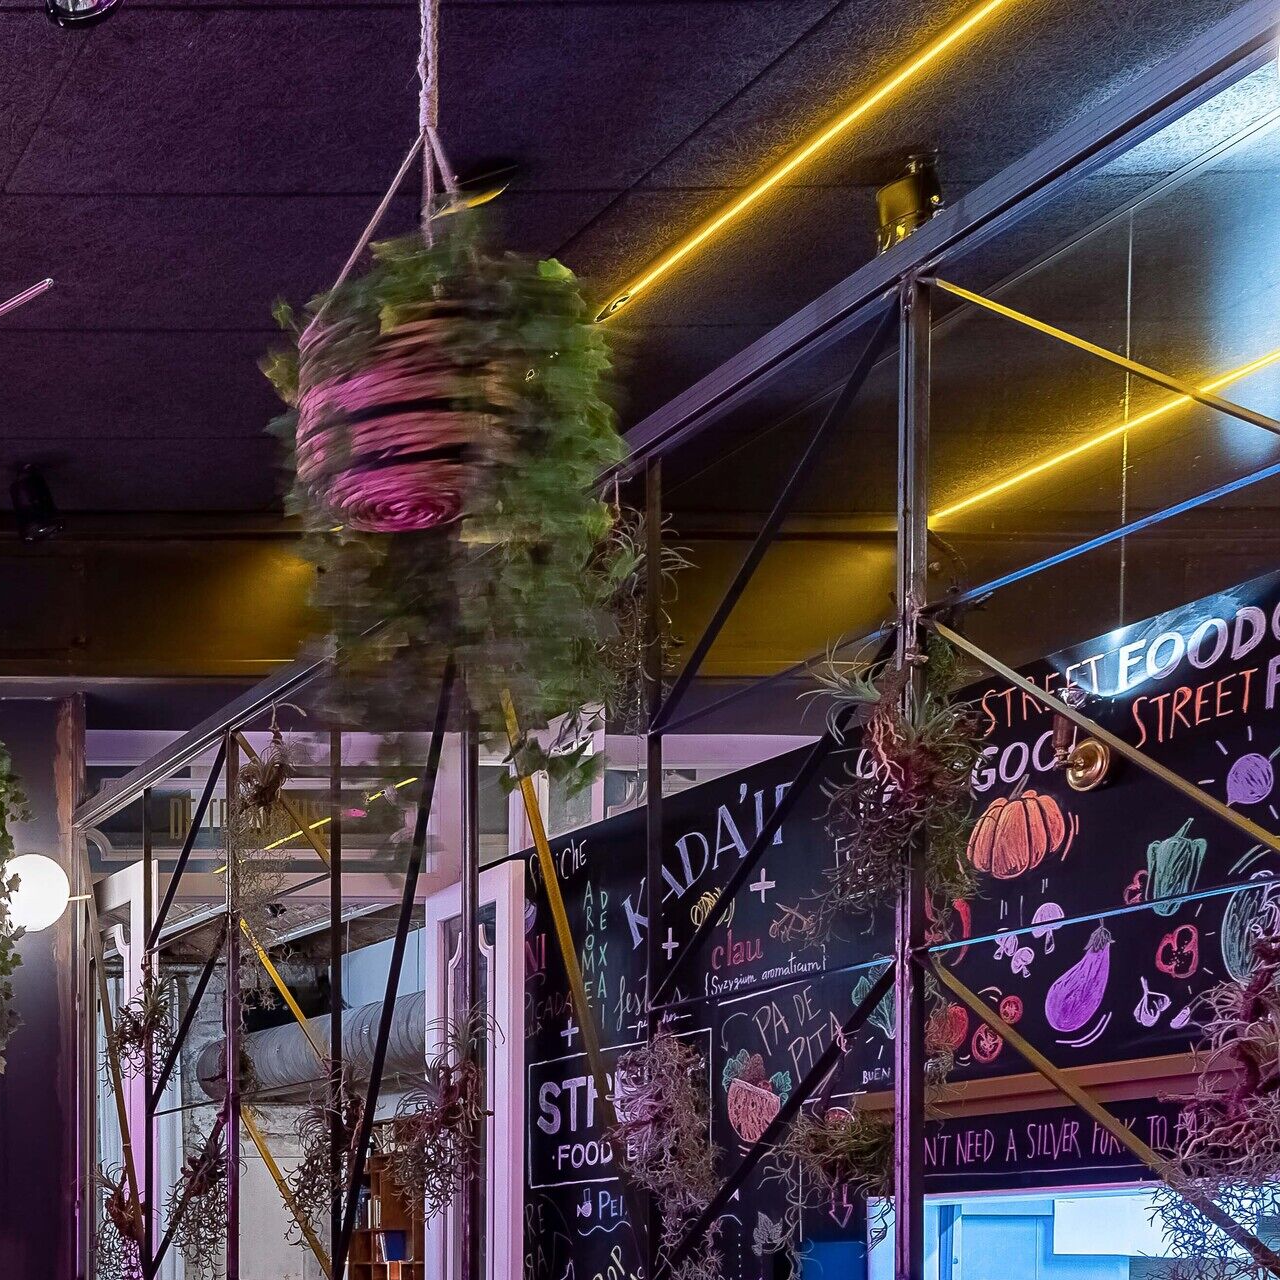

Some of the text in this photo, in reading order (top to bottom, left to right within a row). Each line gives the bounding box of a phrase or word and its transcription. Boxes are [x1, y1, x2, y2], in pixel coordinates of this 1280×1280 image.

[1116, 605, 1266, 693] FOOD
[1132, 667, 1258, 748] STREET
[711, 929, 763, 971] clau
[752, 985, 822, 1057] PA DE
[557, 1141, 614, 1171] FOOD
[956, 1128, 994, 1166] NEED
[1005, 1134, 1018, 1163] A
[1026, 1117, 1082, 1161] SILVER
[1146, 1115, 1168, 1150] TO
